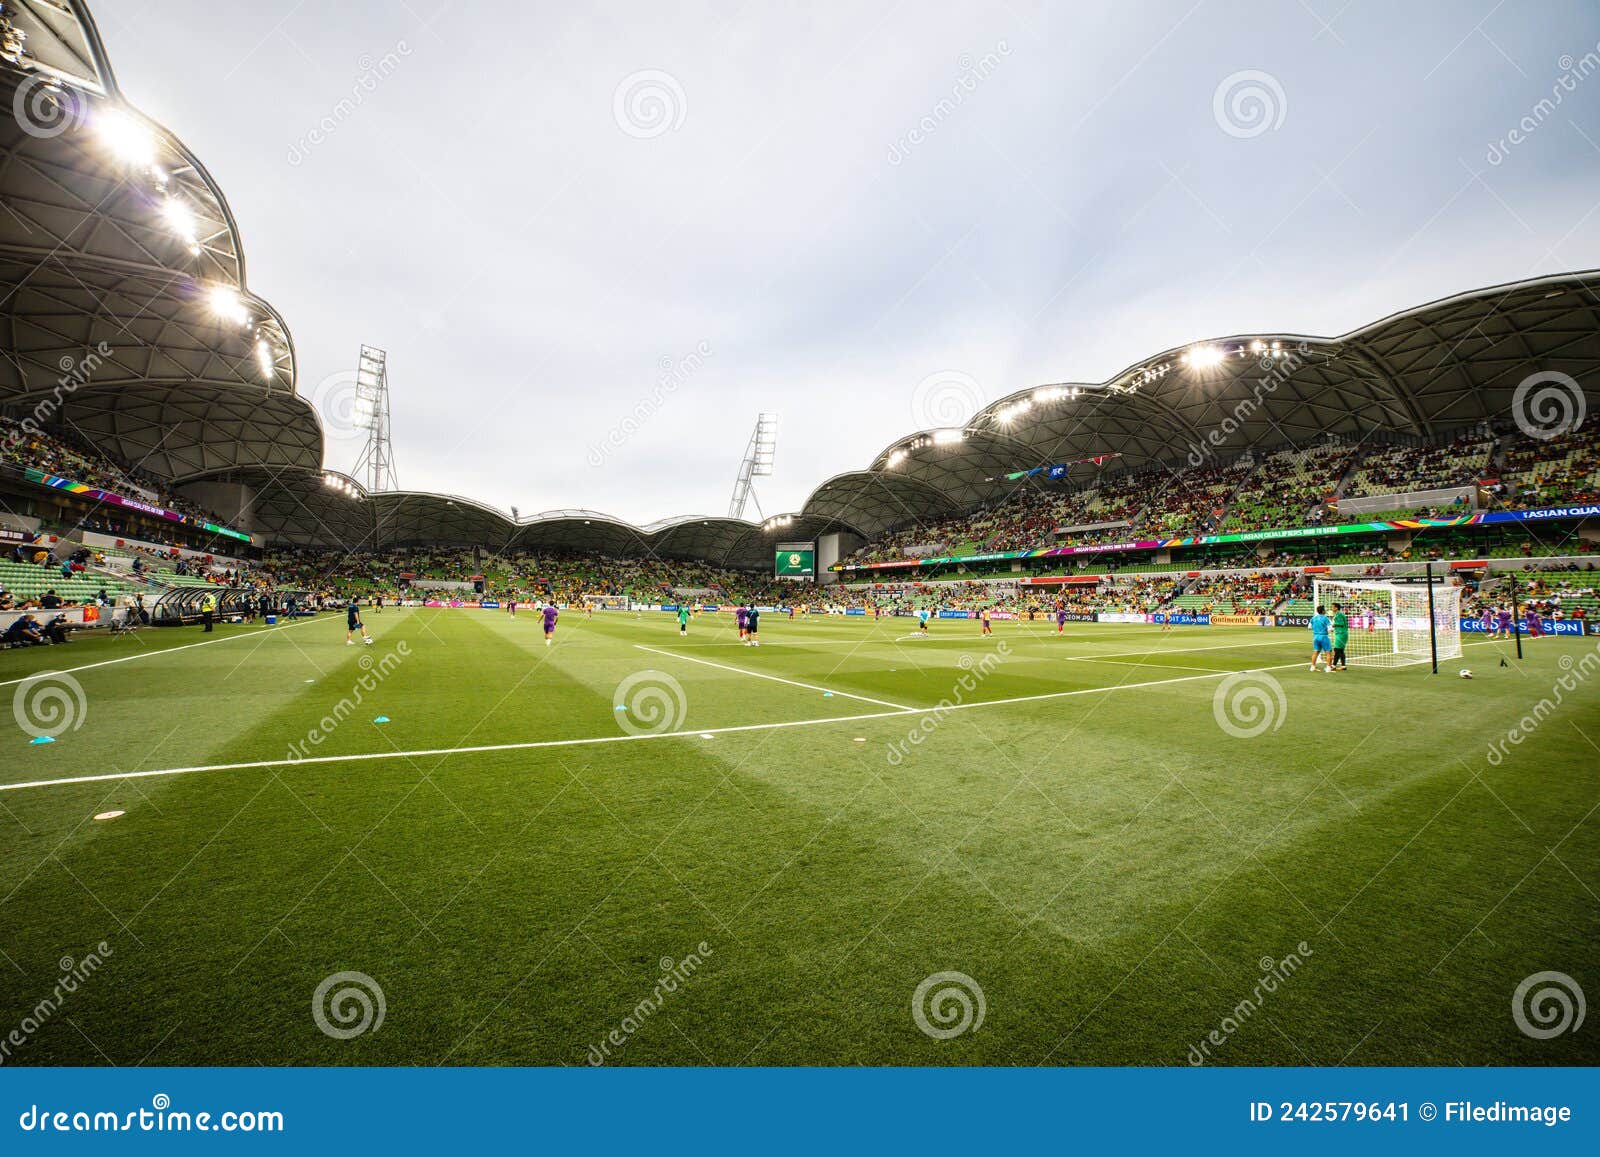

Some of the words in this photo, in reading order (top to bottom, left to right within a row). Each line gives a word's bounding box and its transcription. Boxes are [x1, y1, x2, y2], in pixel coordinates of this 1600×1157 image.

[1528, 509, 1567, 518] ASIAN
[1210, 616, 1248, 625] Continental
[1288, 617, 1309, 625] NEO
